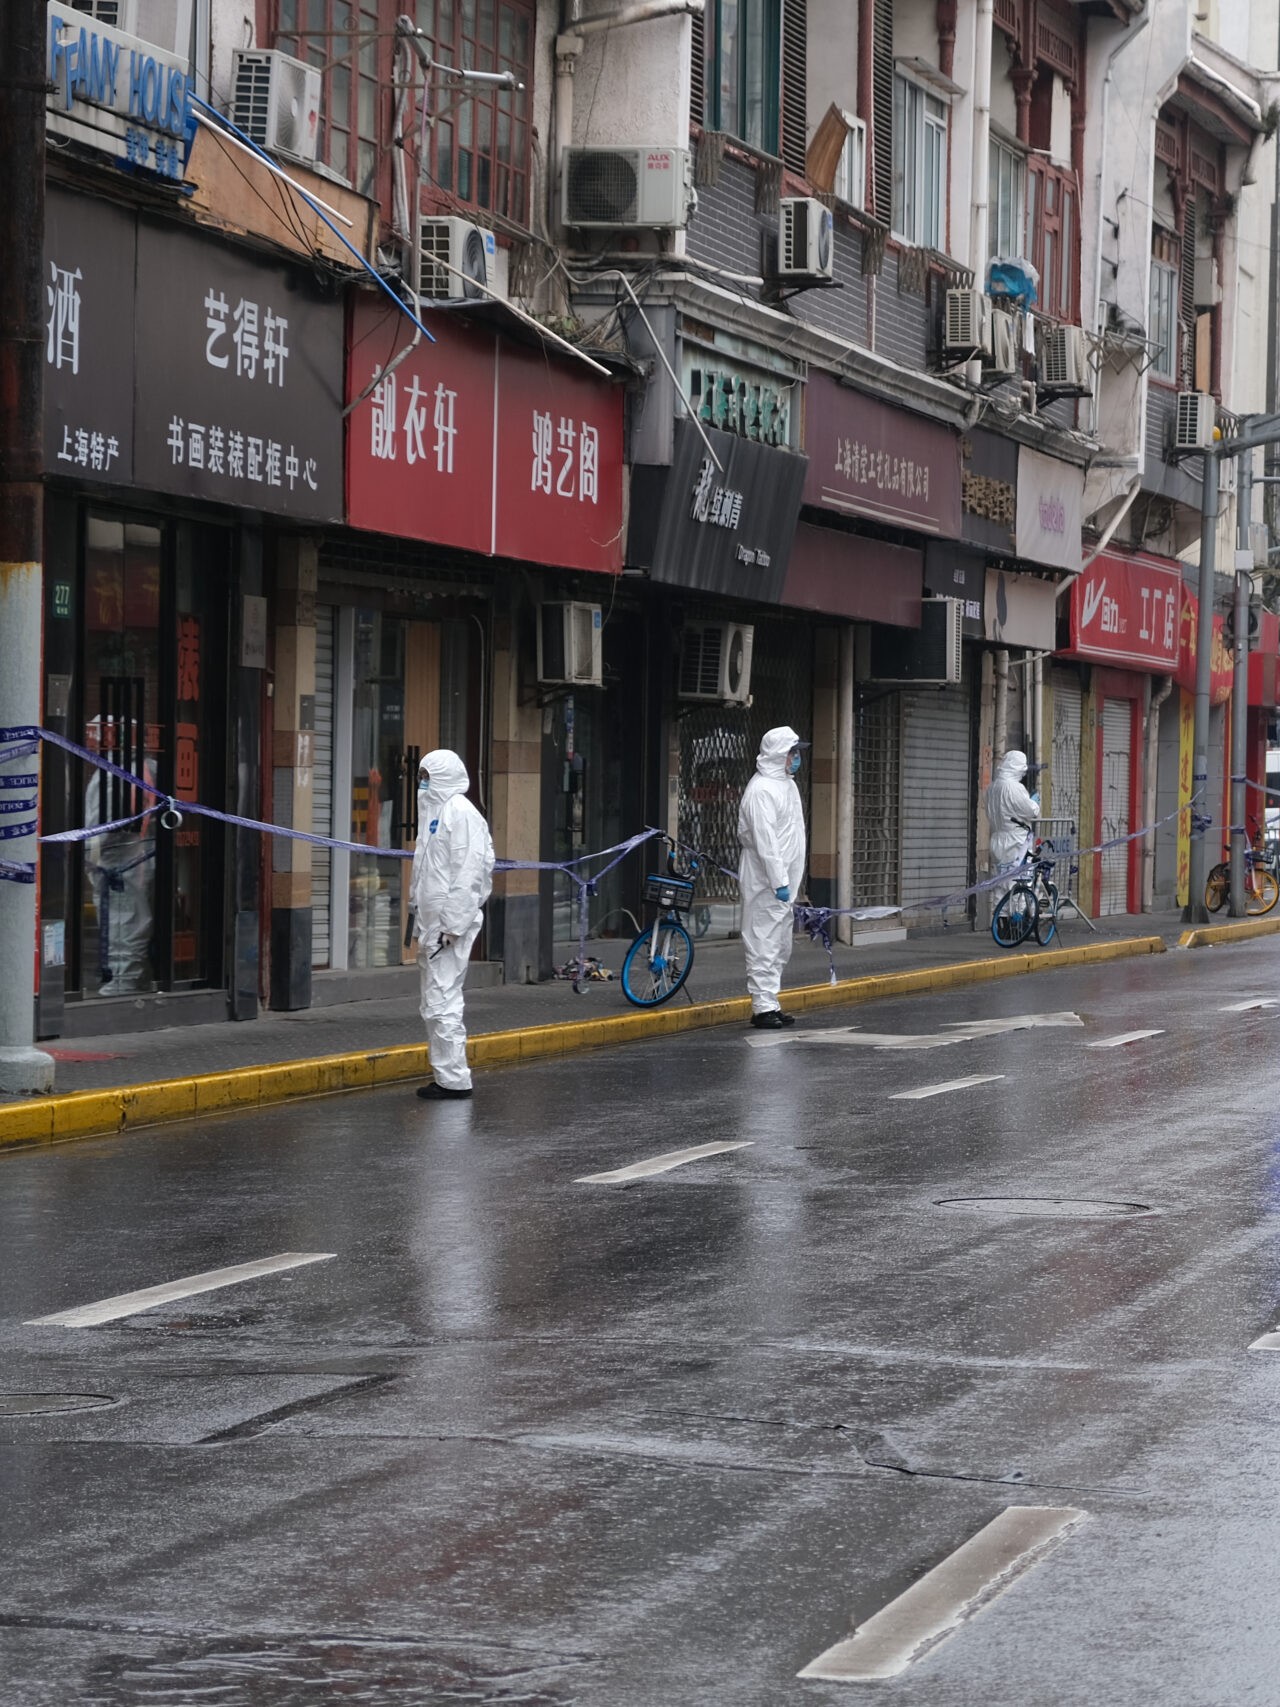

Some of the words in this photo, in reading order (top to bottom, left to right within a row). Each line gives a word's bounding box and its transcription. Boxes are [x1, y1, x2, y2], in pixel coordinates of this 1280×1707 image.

[129, 50, 194, 140] HOUSE
[47, 260, 83, 375] 酒
[204, 287, 289, 387] 艺得轩
[58, 424, 119, 471] 上海特产
[167, 415, 318, 491] 书画装裱配框中心
[370, 364, 458, 473] 靓衣轩
[531, 409, 598, 504] 鸿艺阁
[1101, 596, 1119, 633] 回力
[1139, 587, 1176, 650] 工厂店
